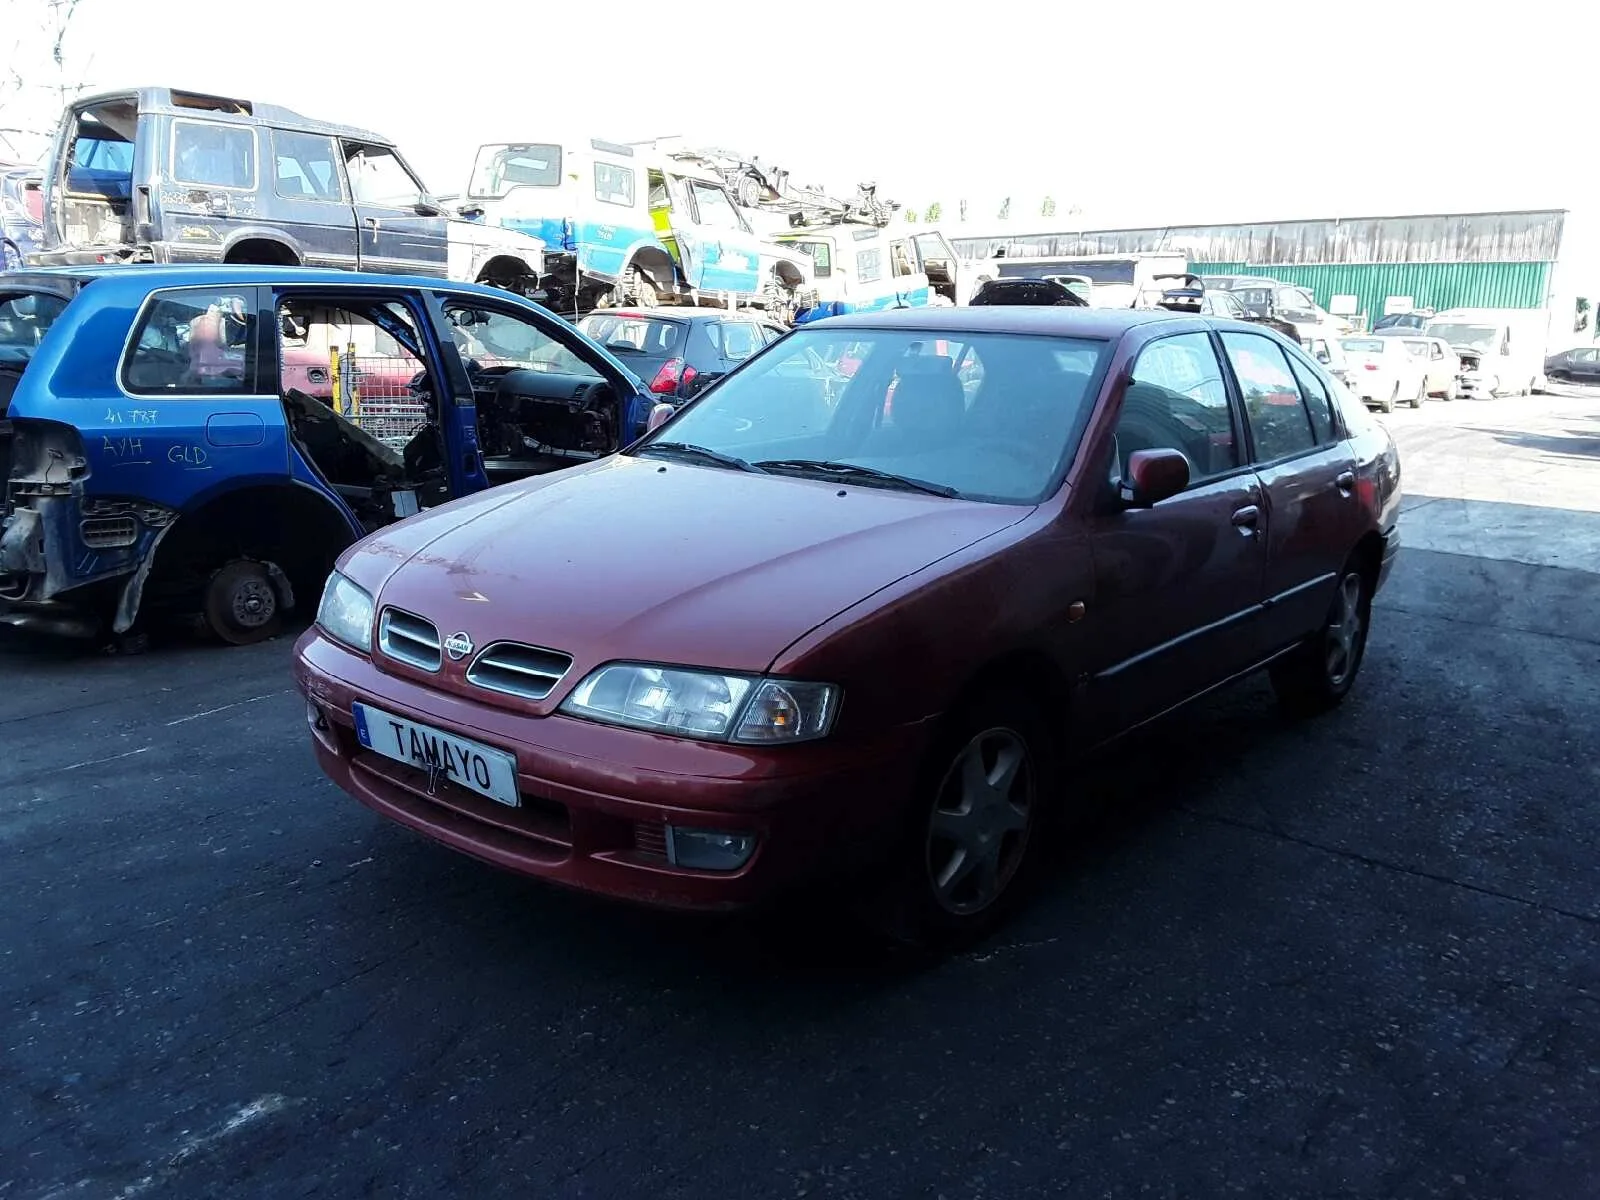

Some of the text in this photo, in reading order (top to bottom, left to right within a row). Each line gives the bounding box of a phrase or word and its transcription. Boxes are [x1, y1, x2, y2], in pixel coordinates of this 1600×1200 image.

[167, 445, 208, 465] GLD
[446, 639, 469, 652] NISSAN
[388, 720, 491, 790] TAMAYO
